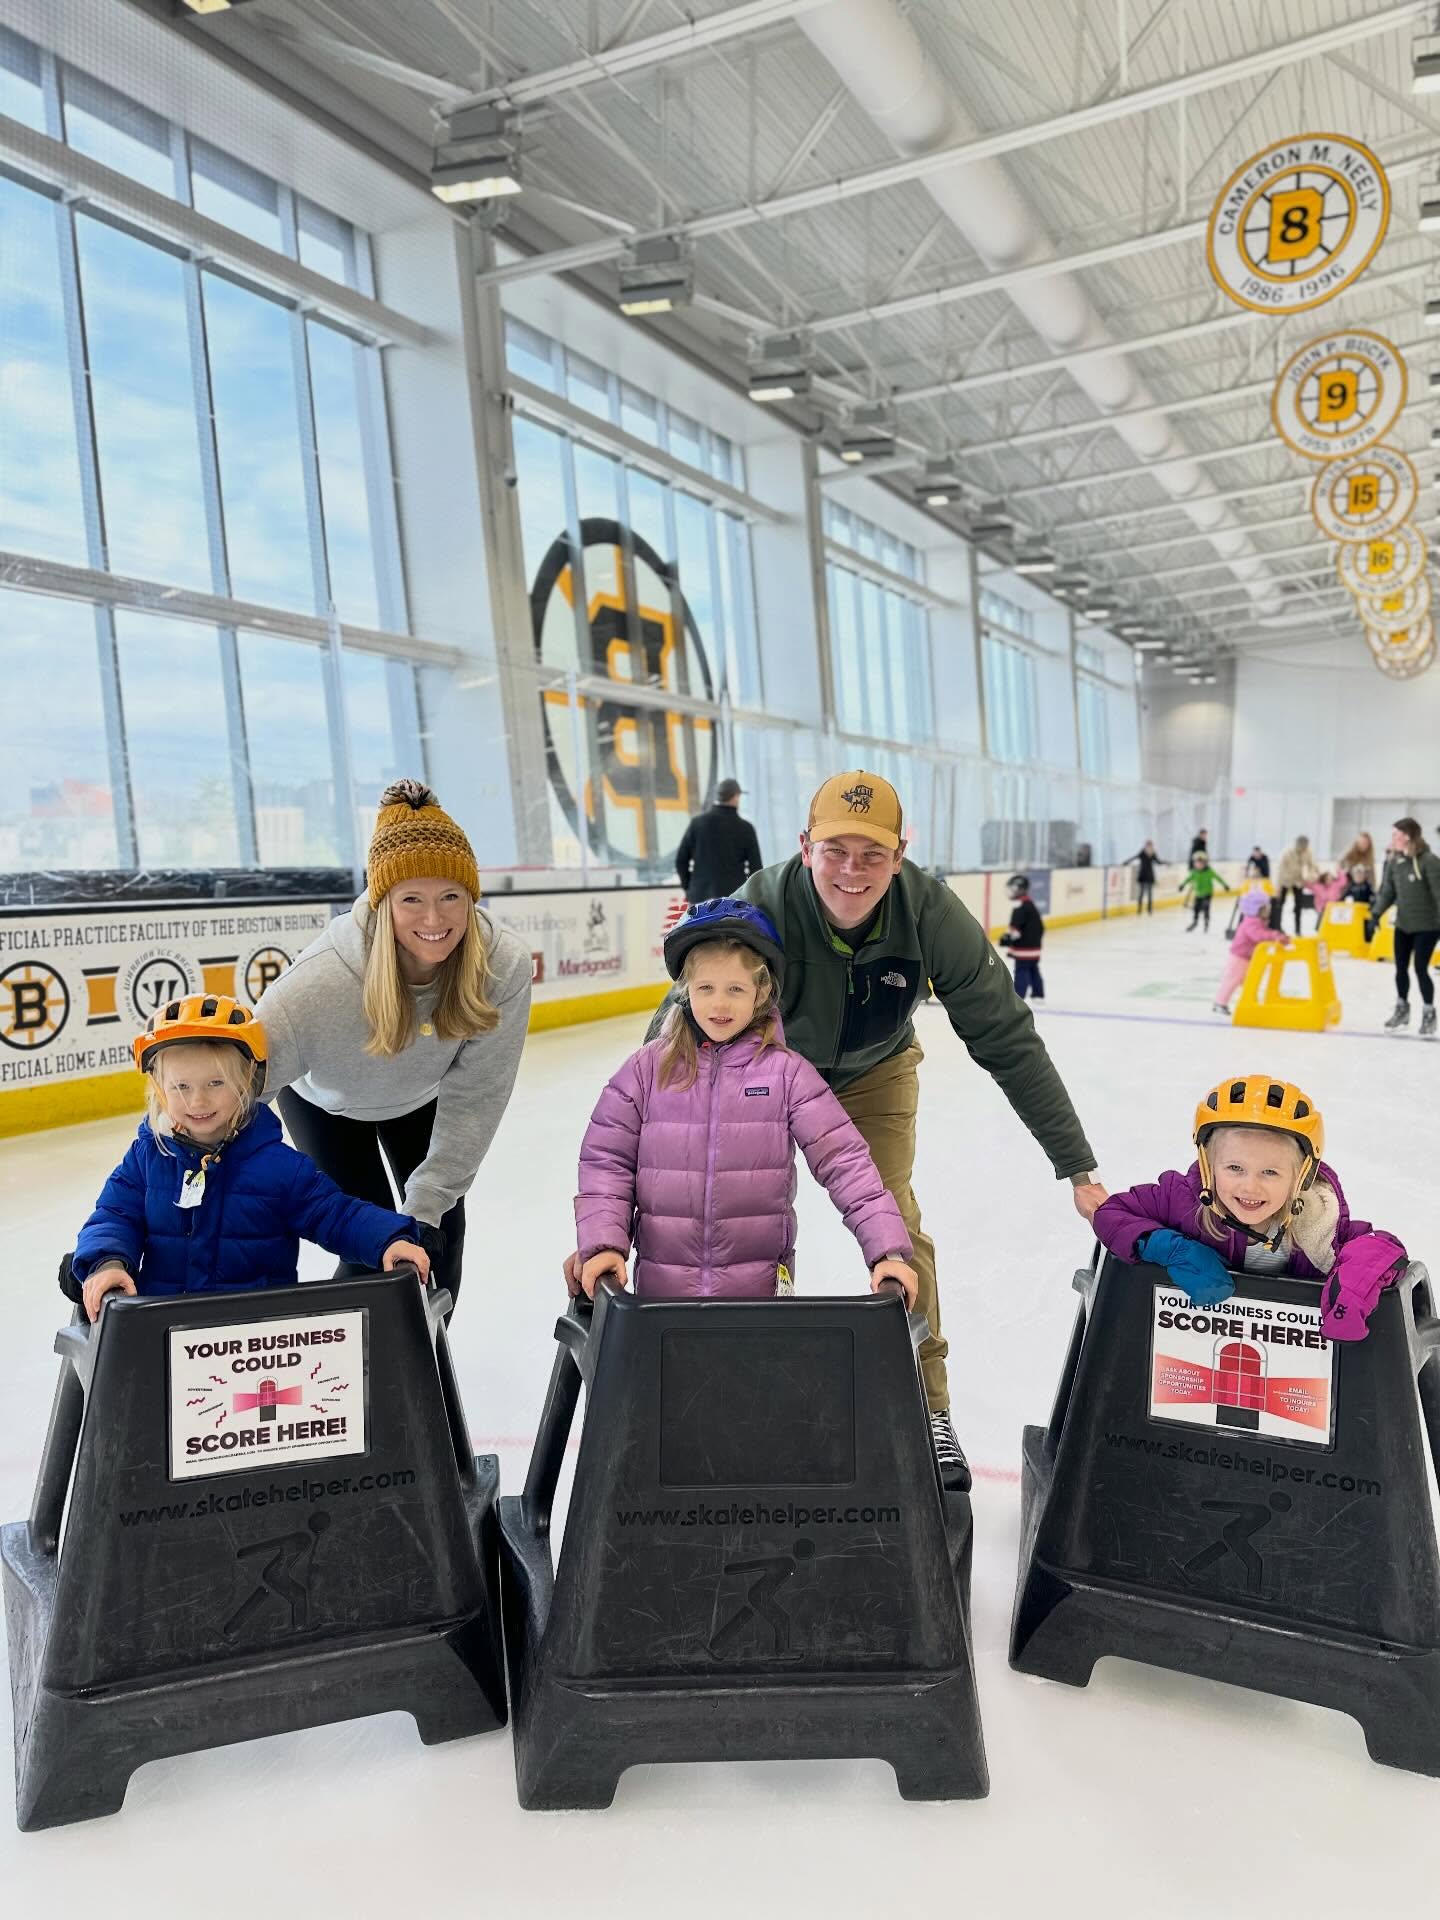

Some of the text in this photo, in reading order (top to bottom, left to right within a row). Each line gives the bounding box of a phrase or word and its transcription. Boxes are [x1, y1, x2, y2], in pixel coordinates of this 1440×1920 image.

[1219, 145, 1377, 235] CAMERON M. NEELY
[1279, 206, 1308, 243] 8
[1240, 277, 1283, 303] 1986
[1299, 263, 1346, 298] 1996
[1327, 383, 1347, 409] 9
[1353, 483, 1373, 505] 15
[1372, 549, 1390, 567] 16
[53, 925, 127, 947] PRACTICE
[129, 920, 190, 941] FACILITY
[192, 920, 207, 937] OF
[210, 918, 236, 936] THE
[237, 916, 282, 935] BOSTON
[284, 913, 325, 931] BRUINS
[56, 1050, 96, 1074] HOME
[1158, 1310, 1328, 1350] SCORE HERE!
[184, 1328, 346, 1360] YOUR BUSINESS
[232, 1352, 302, 1373] COULD
[1179, 1368, 1200, 1376] ABOUT
[1158, 1380, 1206, 1391] OPPORTUNITIES
[1160, 1373, 1204, 1383] SPONSORSHIP
[1288, 1387, 1309, 1395] EMAIL
[1290, 1398, 1317, 1407] INQUIRE
[186, 1426, 271, 1456] SCORE
[278, 1416, 347, 1442] HERE!
[1104, 1430, 1382, 1496] www.skatehelper.com
[120, 1468, 416, 1527] www.skatehelper.com
[616, 1503, 900, 1528] www.skatehelper.com
